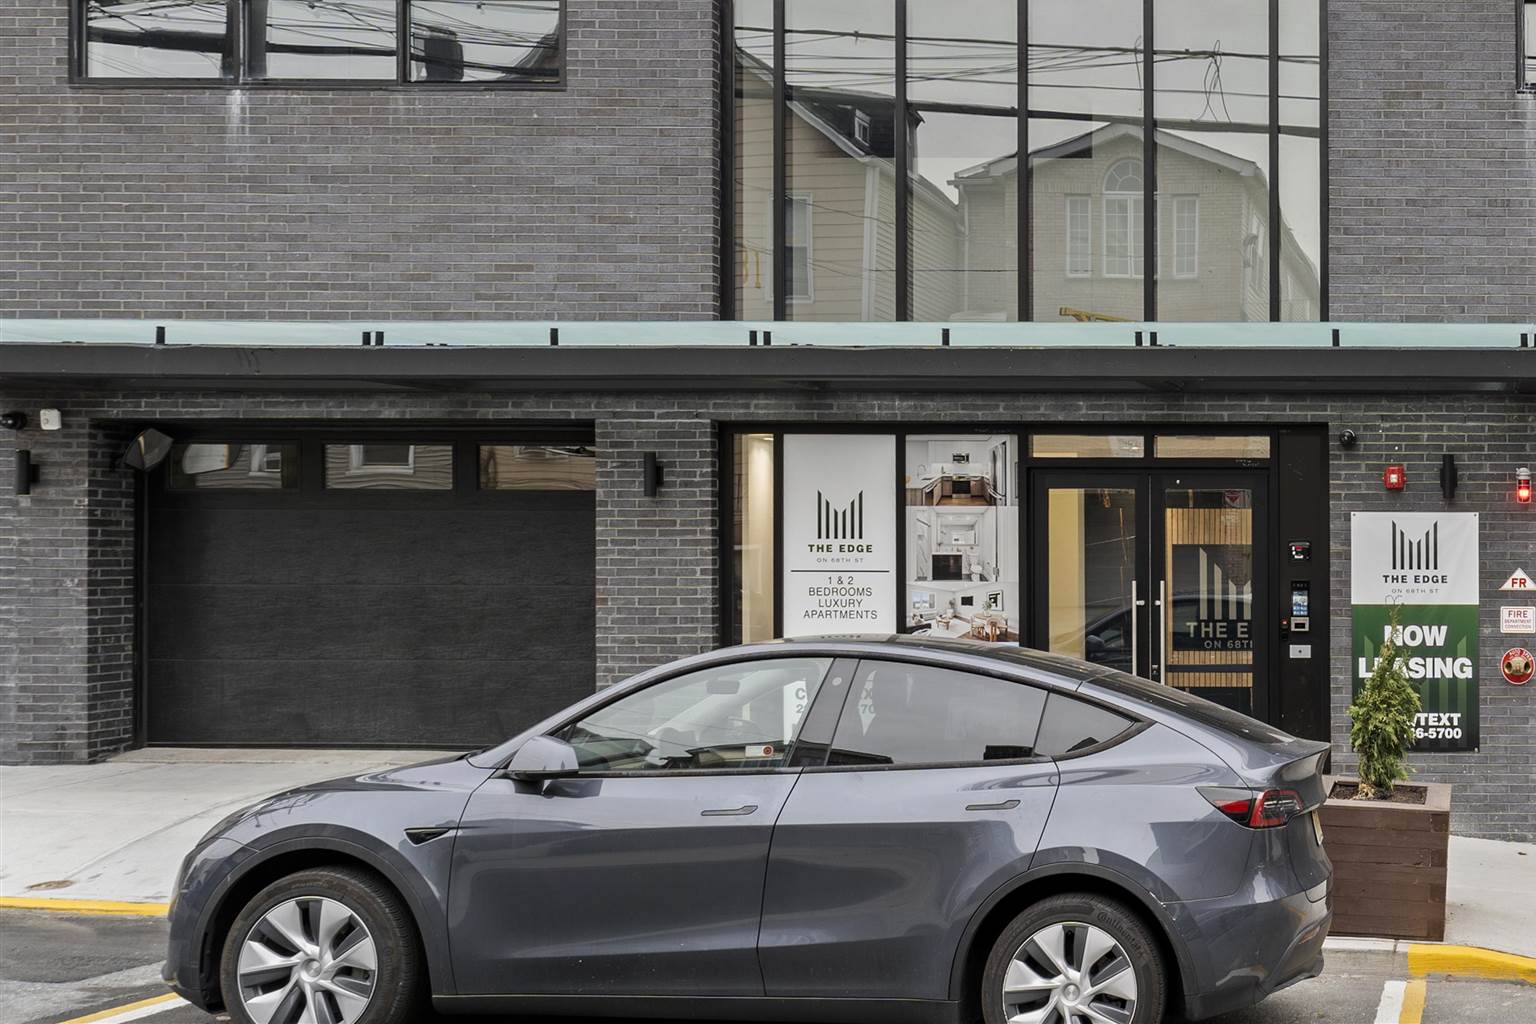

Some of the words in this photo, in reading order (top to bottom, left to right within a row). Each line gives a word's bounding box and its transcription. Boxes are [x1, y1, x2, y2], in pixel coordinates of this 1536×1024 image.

[808, 544, 833, 553] THE
[839, 544, 873, 553] EDGE
[828, 576, 832, 585] 1
[837, 576, 843, 585] &
[847, 576, 854, 585] 2
[1382, 575, 1408, 584] THE
[1414, 575, 1448, 584] EDGE
[1511, 578, 1527, 588] FR
[808, 586, 873, 597] BEDROOMS
[818, 598, 863, 608] LUXURY
[803, 609, 878, 620] APARTMENTS
[1508, 610, 1528, 618] FIRE
[1186, 622, 1227, 638] THE
[1384, 625, 1447, 646] NOW
[1204, 640, 1222, 649] ON
[1412, 712, 1461, 727] /TEXT
